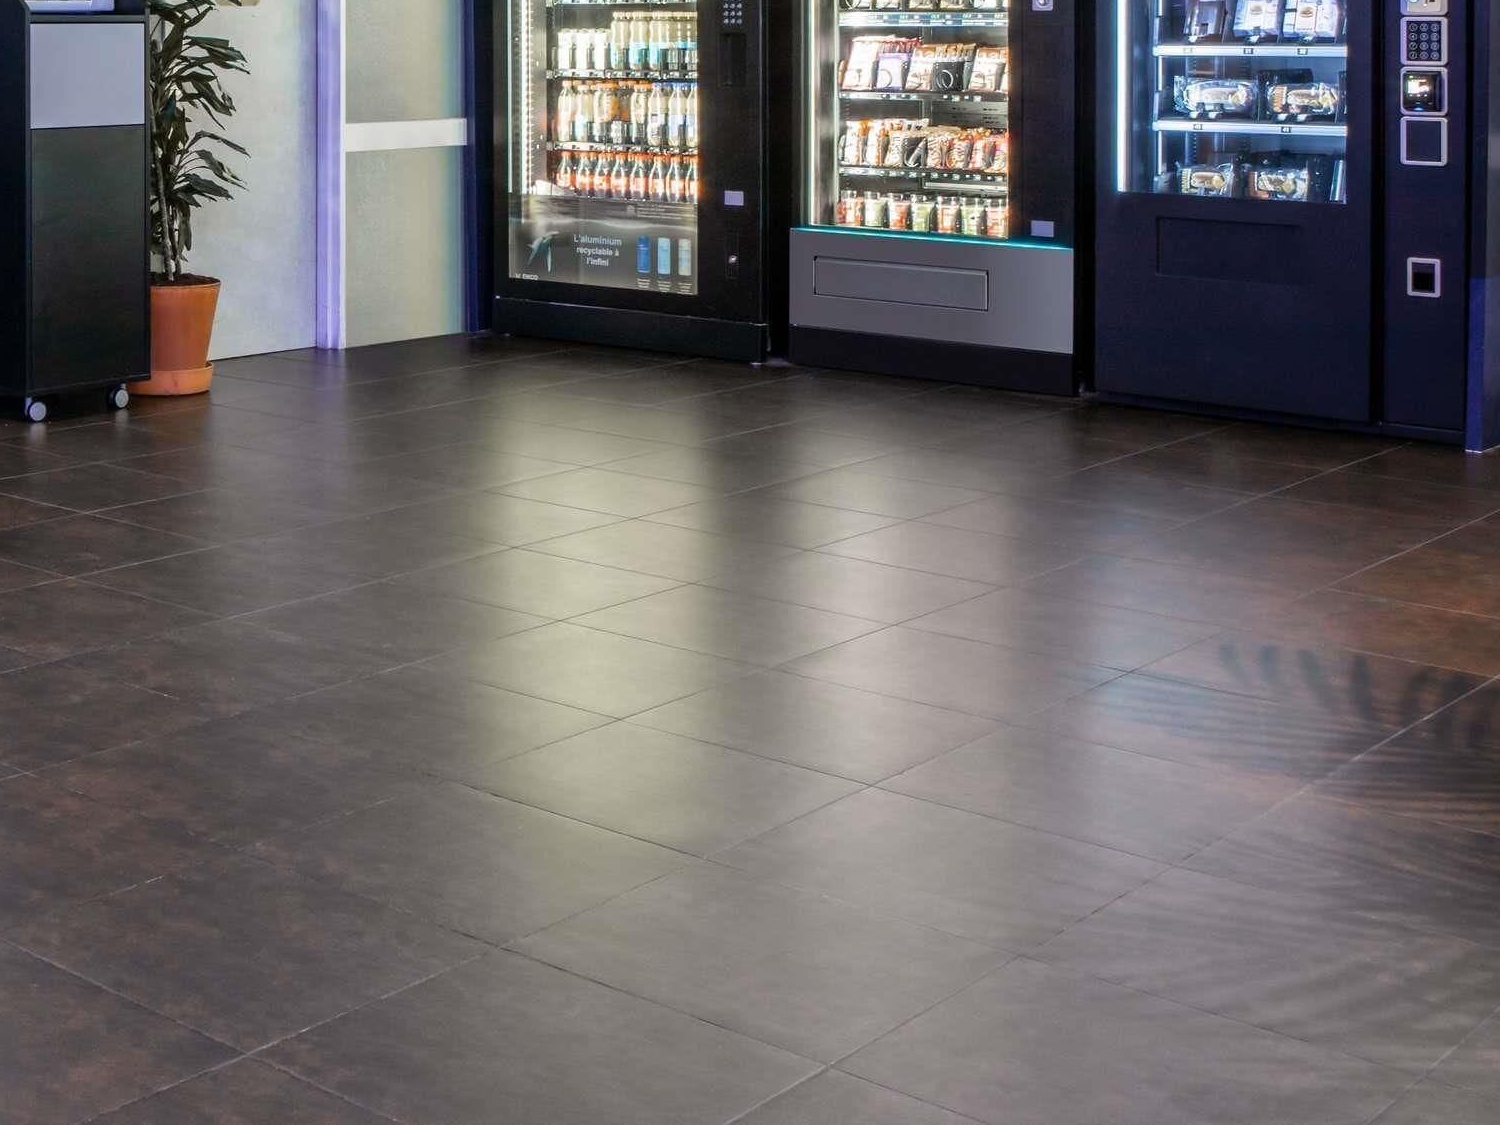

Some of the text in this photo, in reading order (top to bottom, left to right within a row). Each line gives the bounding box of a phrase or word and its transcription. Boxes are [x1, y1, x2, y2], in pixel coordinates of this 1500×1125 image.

[573, 234, 622, 246] L'aluminium
[576, 246, 613, 256] recyclable
[586, 257, 609, 267] l'infini
